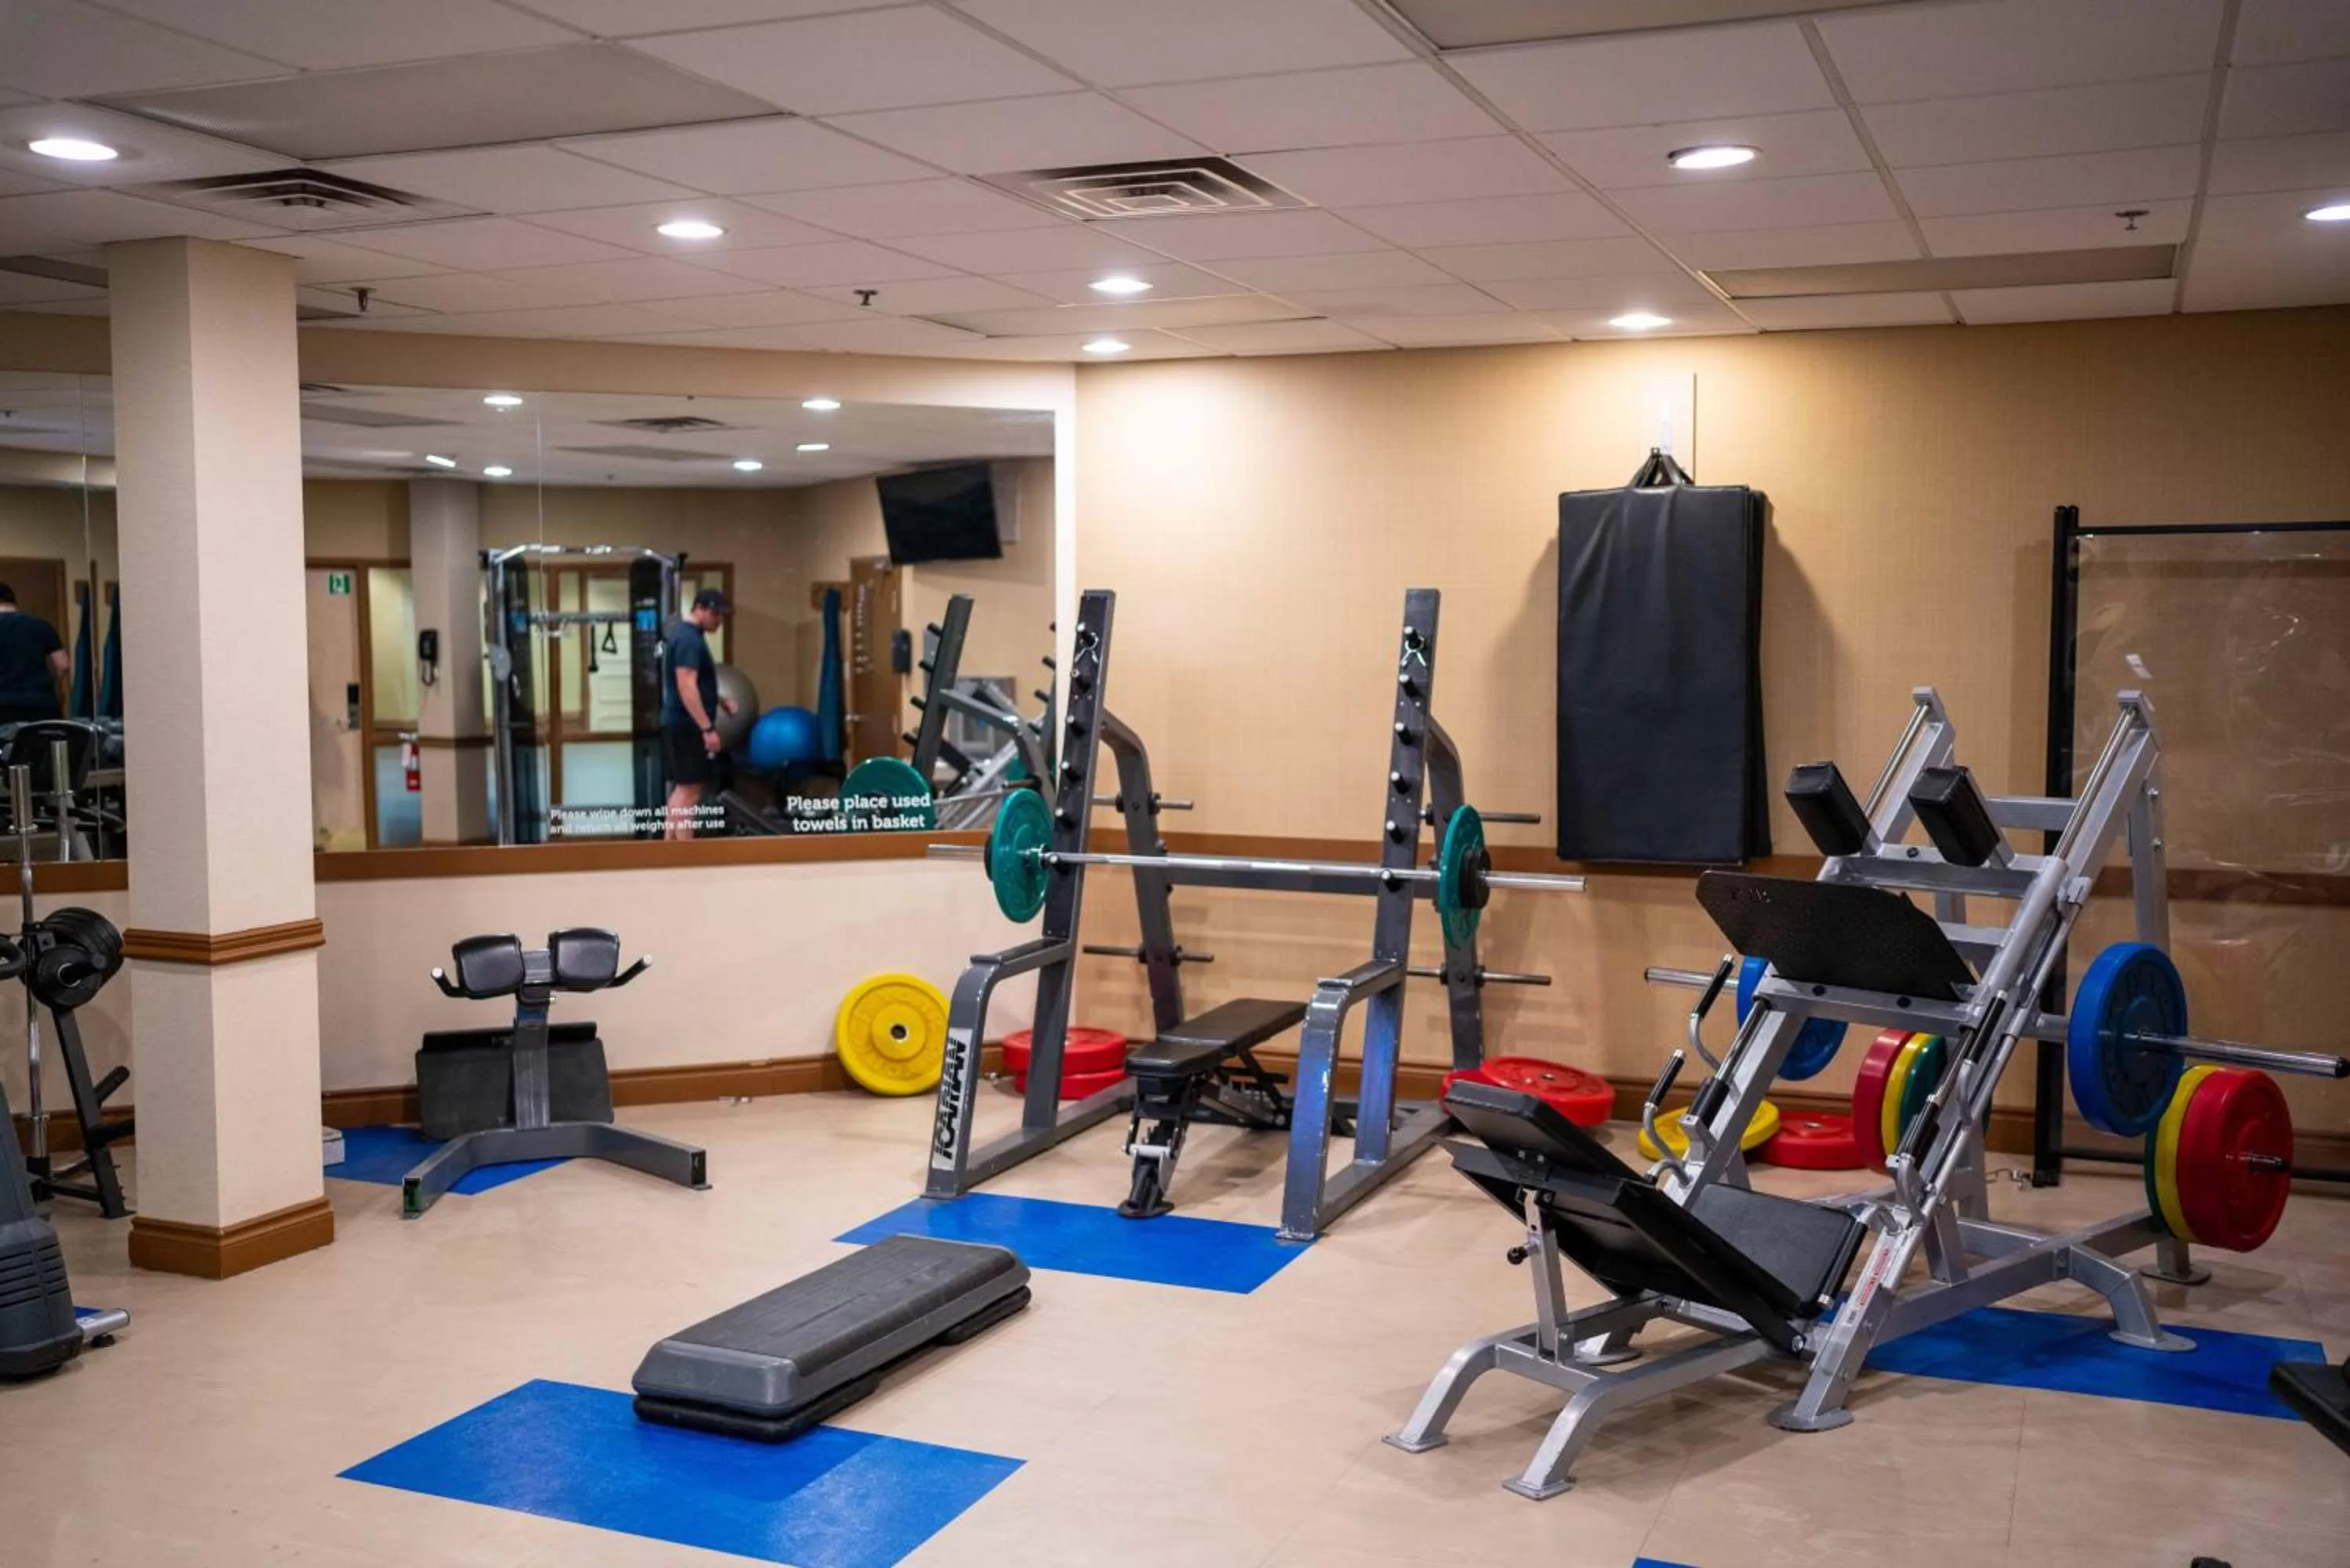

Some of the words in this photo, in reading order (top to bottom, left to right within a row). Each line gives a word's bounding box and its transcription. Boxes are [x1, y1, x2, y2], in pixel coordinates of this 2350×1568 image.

[786, 796, 840, 811] Please
[844, 794, 888, 812] place
[891, 793, 931, 807] used
[551, 809, 586, 819] Please
[589, 808, 617, 820] wipe
[620, 807, 652, 817] down
[655, 806, 668, 816] all
[671, 805, 724, 815] machines
[631, 819, 674, 832] weights
[677, 818, 703, 829] after
[706, 819, 725, 829] use
[793, 816, 848, 832] towels
[851, 815, 869, 829] in
[872, 814, 926, 829] basket
